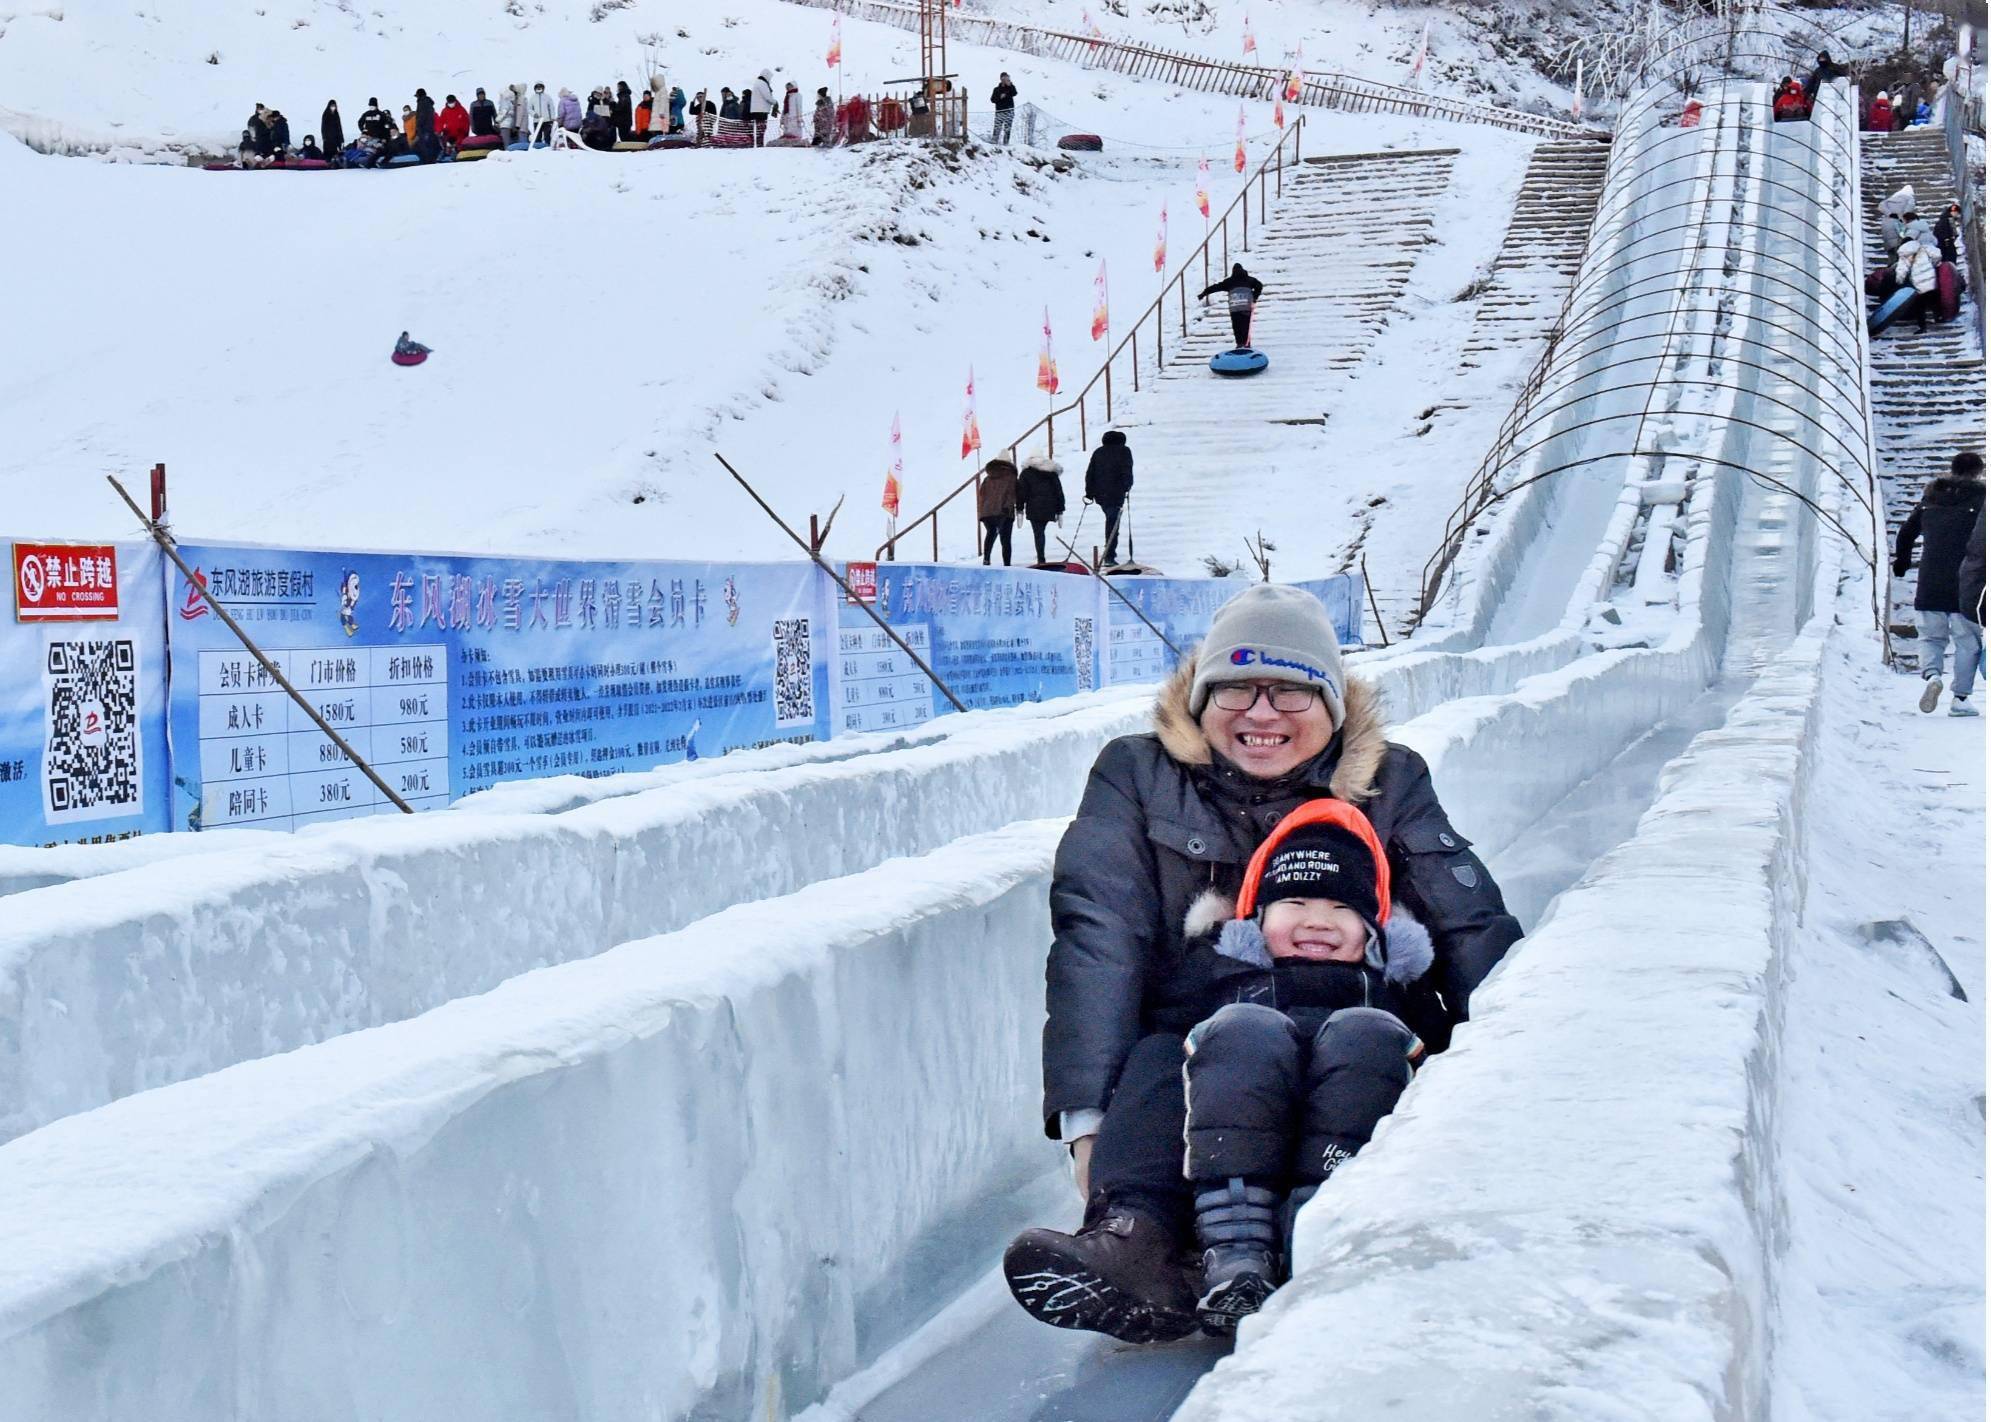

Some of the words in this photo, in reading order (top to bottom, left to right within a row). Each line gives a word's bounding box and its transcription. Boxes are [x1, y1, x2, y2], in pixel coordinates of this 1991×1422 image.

[46, 555, 112, 588] 禁止跨越
[210, 567, 314, 598] 东风湖旅游度假村
[56, 592, 67, 602] NO
[71, 592, 105, 602] CROSSING
[388, 570, 708, 633] 东风湖冰雪大世界滑雪会员卡
[310, 657, 357, 684] 门市价格
[389, 654, 434, 680] 折扣价格
[227, 703, 264, 731] 成人卡
[319, 698, 355, 722] 1580元
[399, 693, 429, 716] 980元
[229, 745, 266, 774] 儿童卡
[400, 731, 428, 755] 580元
[228, 787, 268, 817] 陪同卡
[319, 777, 351, 803] 380元
[401, 768, 430, 793] 200元
[1279, 849, 1331, 862] ANYWHERE
[1287, 861, 1306, 870] AND
[1307, 860, 1340, 873] ROUND
[1293, 871, 1322, 881] DIZZY
[1322, 1143, 1351, 1158] Hey
